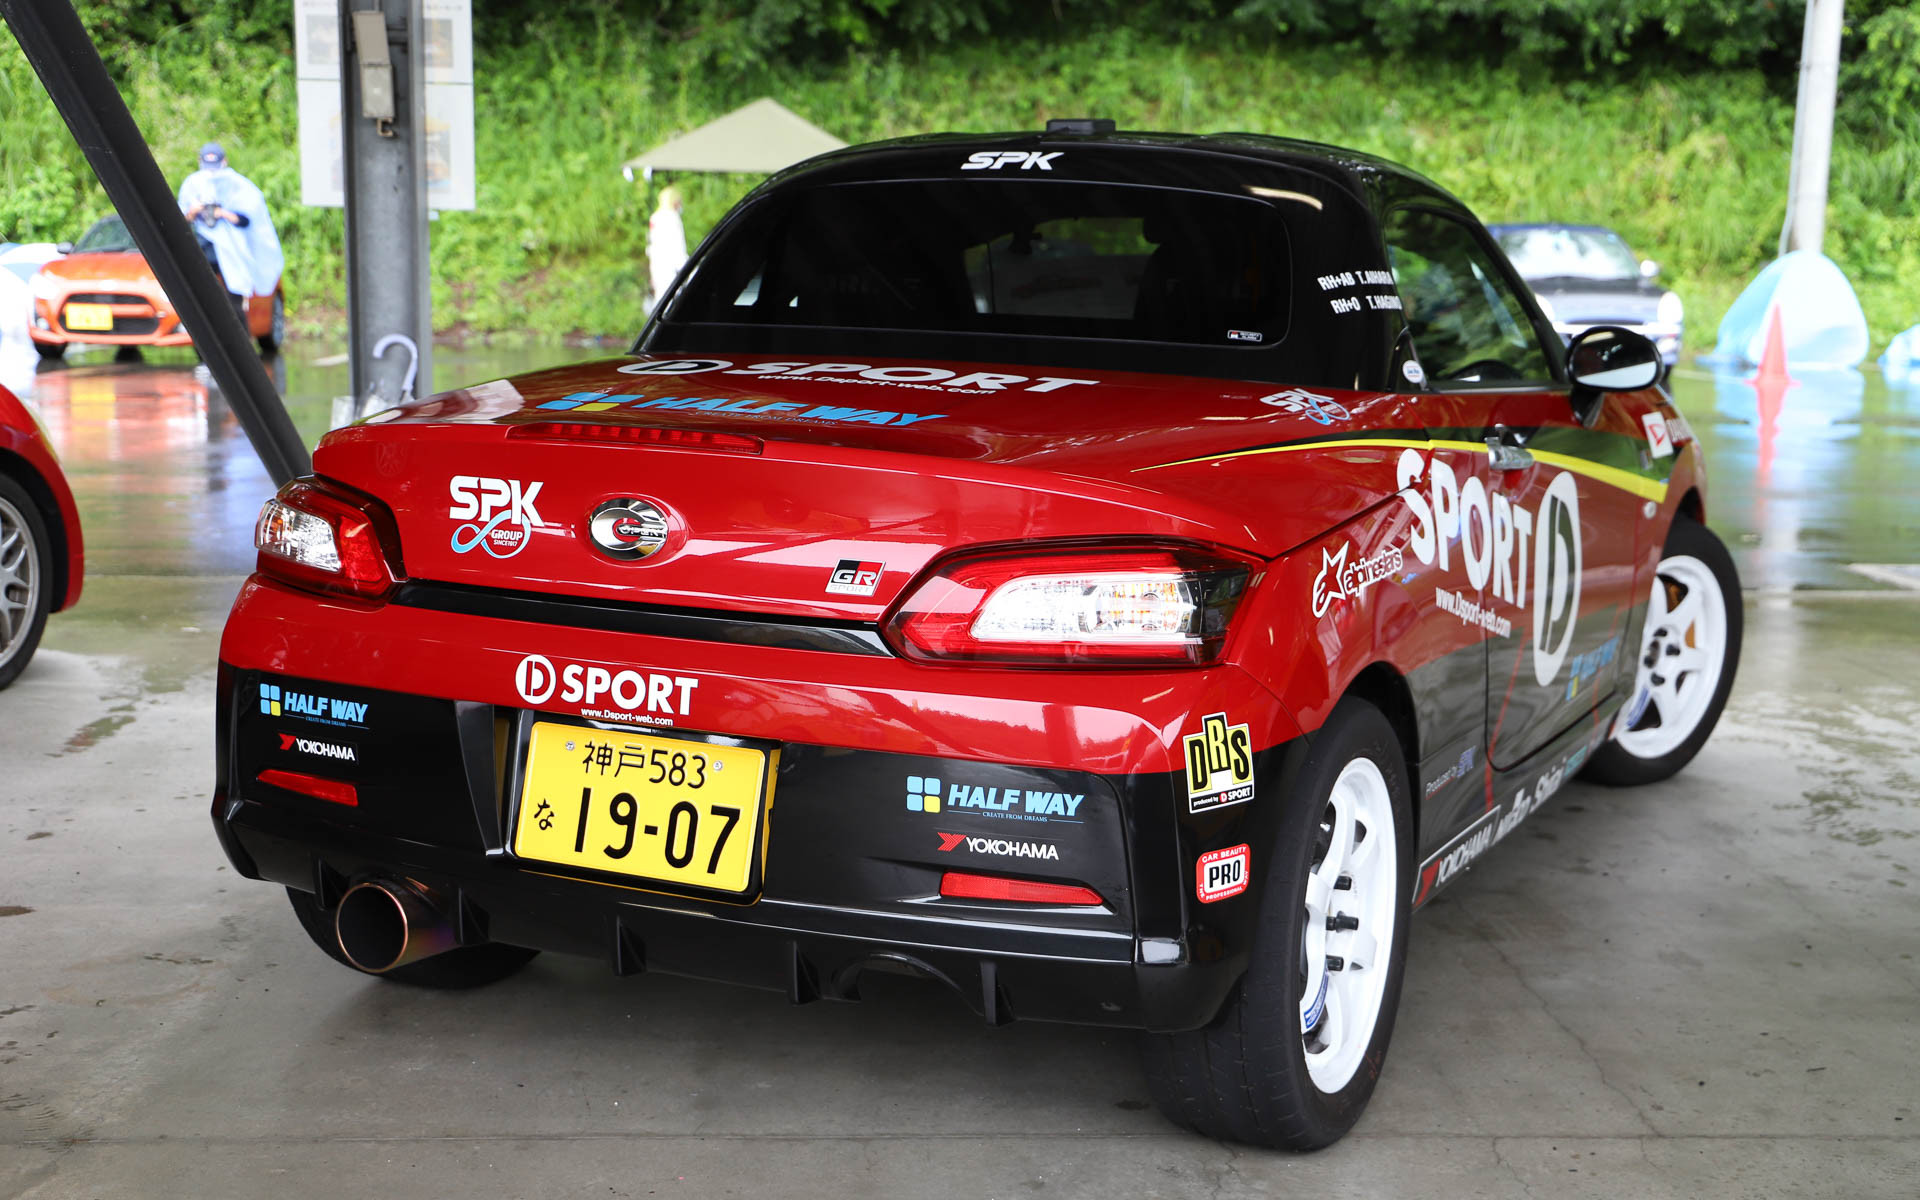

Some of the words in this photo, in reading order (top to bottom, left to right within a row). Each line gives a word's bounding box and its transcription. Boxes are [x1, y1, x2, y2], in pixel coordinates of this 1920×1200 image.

[960, 151, 1065, 171] SPK
[721, 362, 1100, 393] SPORT
[757, 374, 997, 395] www.Dsport-web.com
[630, 396, 809, 415] HALF
[797, 404, 950, 426] WAY
[449, 474, 546, 528] SPK
[491, 529, 524, 541] GROUP
[1396, 448, 1532, 609] SPORT
[832, 569, 878, 587] GR
[560, 663, 699, 716] SPORT
[284, 691, 329, 716] HALF
[330, 698, 369, 723] WAY
[580, 707, 674, 727] www.Dsport-web.com
[295, 737, 356, 761] YOKOHAMA
[1188, 719, 1250, 791] DRS
[947, 783, 1021, 811] HALF
[1025, 790, 1084, 817] WAY
[1228, 787, 1251, 800] SPORT
[533, 797, 556, 831] な
[982, 811, 1005, 820] CREATE
[1005, 813, 1023, 821] FROM
[1023, 815, 1048, 823] DREAMS
[574, 786, 742, 875] 19-07
[965, 836, 1060, 861] YOKOHAMA
[1202, 853, 1218, 863] CAR
[1220, 846, 1247, 858] BEAUTY
[1209, 859, 1241, 889] PRO
